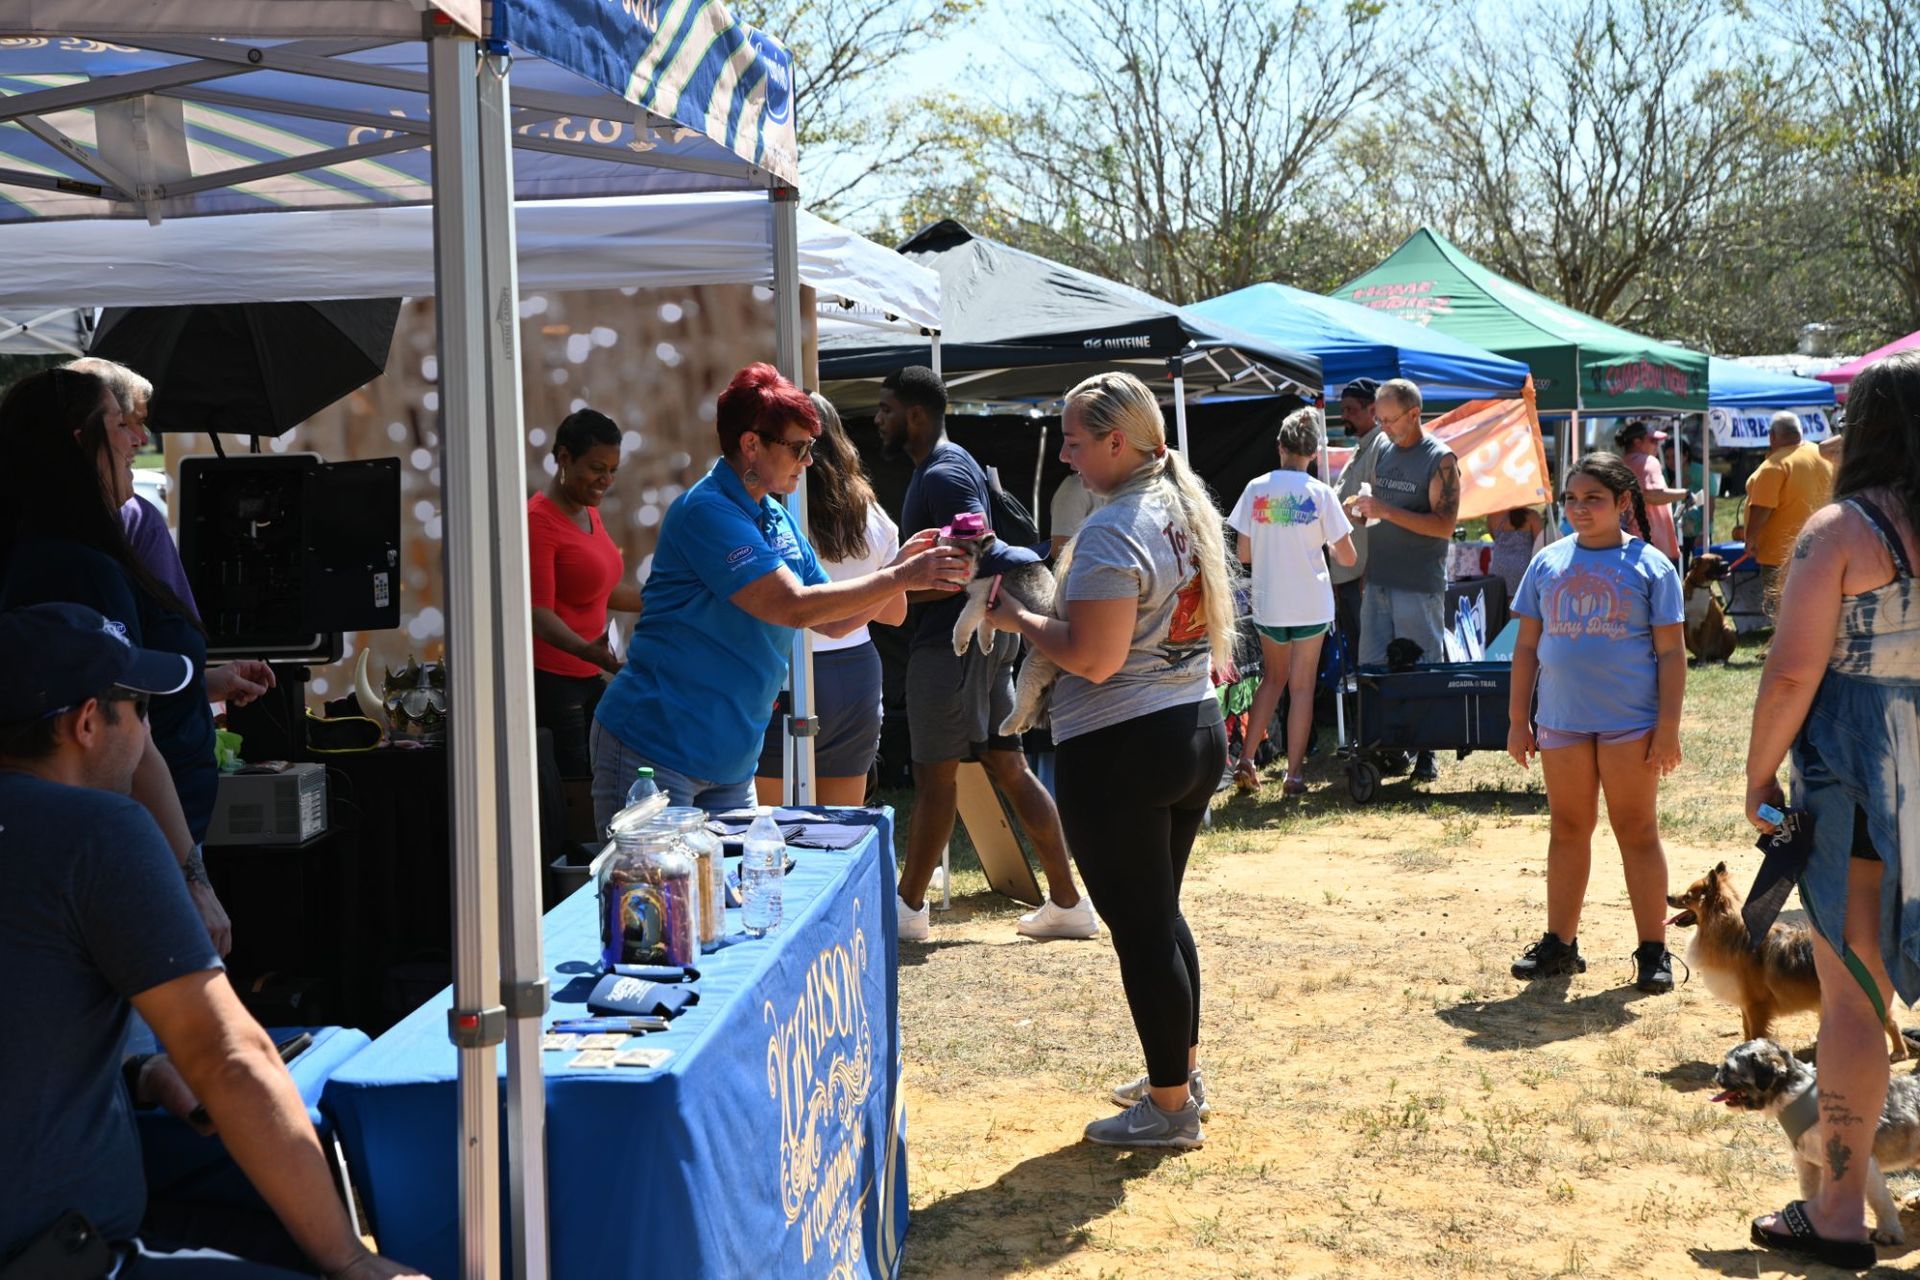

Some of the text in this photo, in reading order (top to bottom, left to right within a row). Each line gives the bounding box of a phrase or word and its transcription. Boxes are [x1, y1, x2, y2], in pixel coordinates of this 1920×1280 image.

[1104, 335, 1151, 350] OUTFINE
[1585, 616, 1628, 641] Days
[1447, 679, 1497, 689] ARCADIA TRAIL
[766, 925, 868, 1143] GRAYSON
